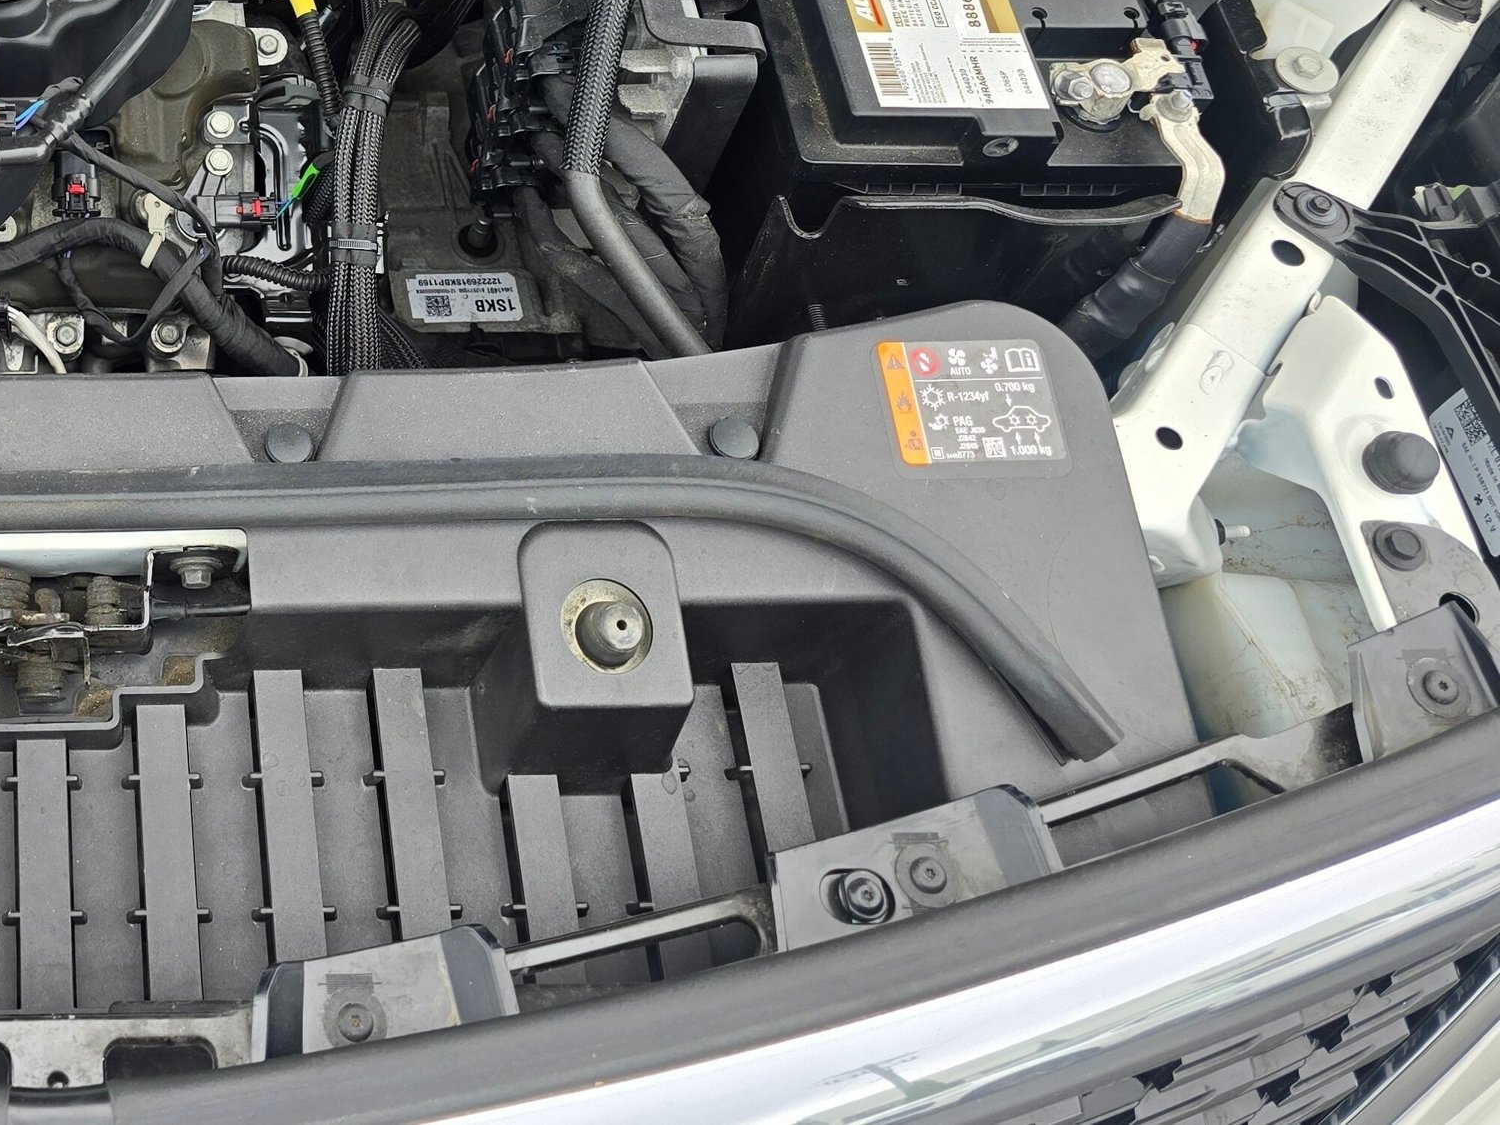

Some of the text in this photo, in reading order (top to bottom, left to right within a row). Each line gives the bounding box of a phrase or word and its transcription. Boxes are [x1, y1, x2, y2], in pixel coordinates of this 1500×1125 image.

[901, 10, 911, 27] FREE
[934, 12, 944, 24] 850
[970, 56, 993, 103] 94RAGMHR
[475, 299, 516, 312] 1SKB
[950, 367, 971, 375] AUTO
[995, 382, 1035, 392] 0.700 kg
[947, 391, 989, 402] R-1234yf
[952, 416, 973, 426] PAG
[1011, 445, 1052, 456] 1.000 kg
